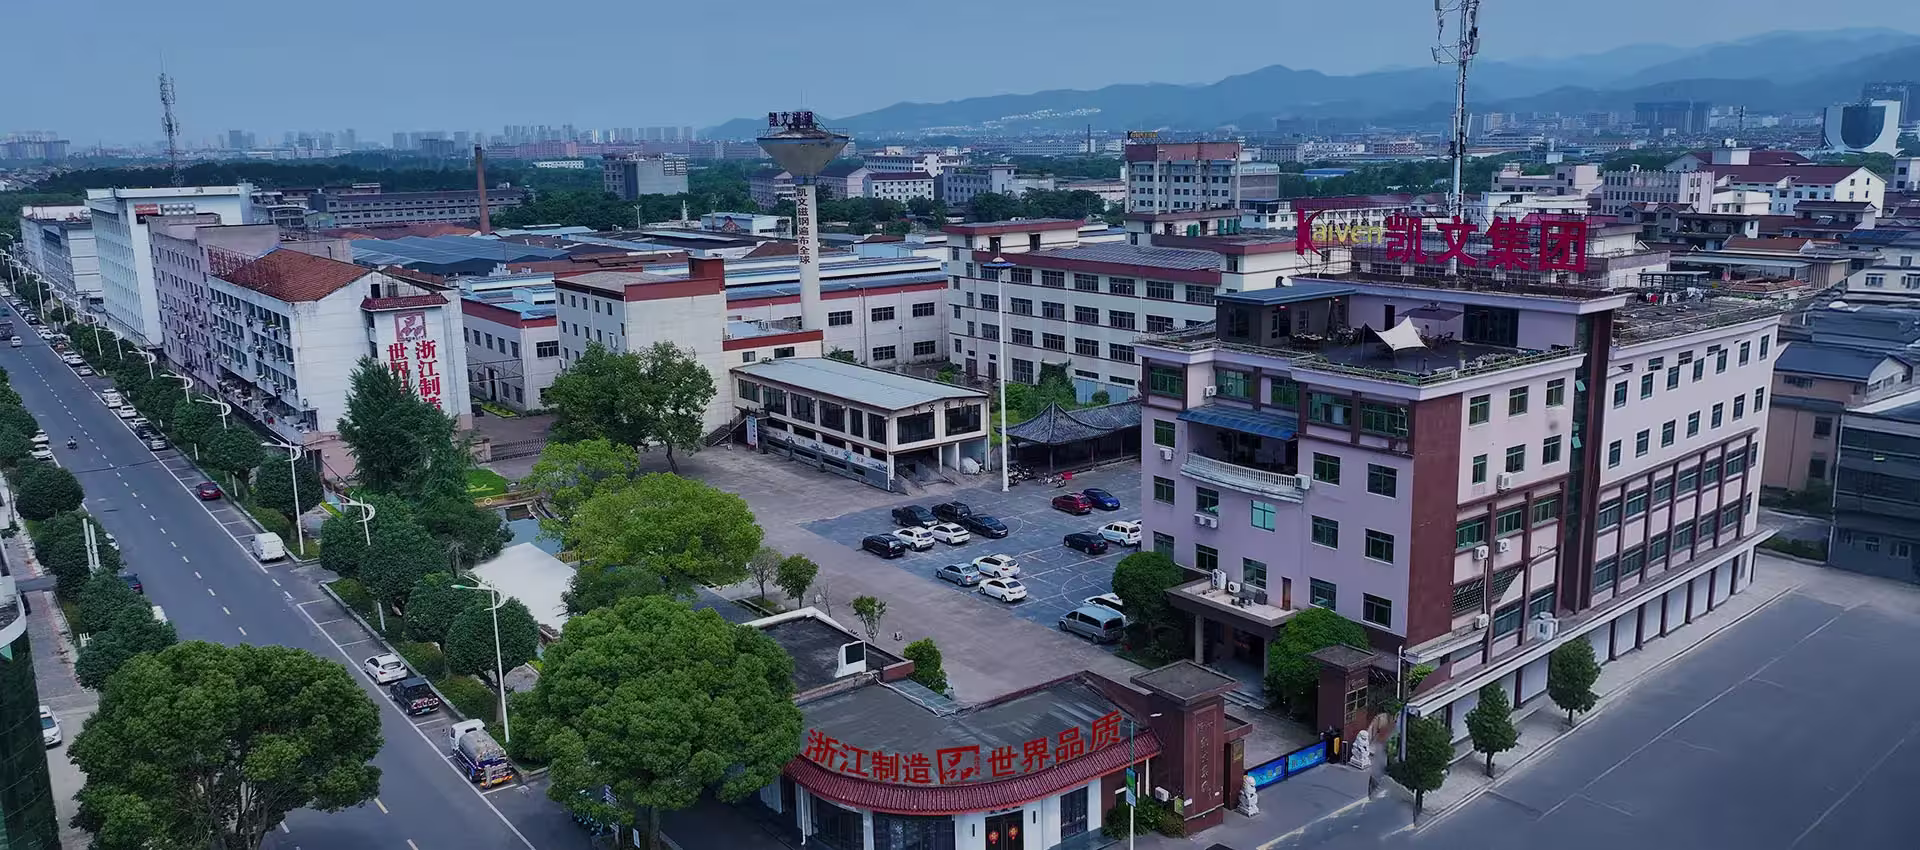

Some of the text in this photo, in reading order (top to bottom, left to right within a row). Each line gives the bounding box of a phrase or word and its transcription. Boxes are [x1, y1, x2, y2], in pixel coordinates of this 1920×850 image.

[797, 188, 810, 265] 凯文磁钢遍布全球
[1295, 208, 1587, 273] Kaiven 凯文集团
[803, 728, 932, 783] 浙江制造
[986, 710, 1124, 777] 世界品质
